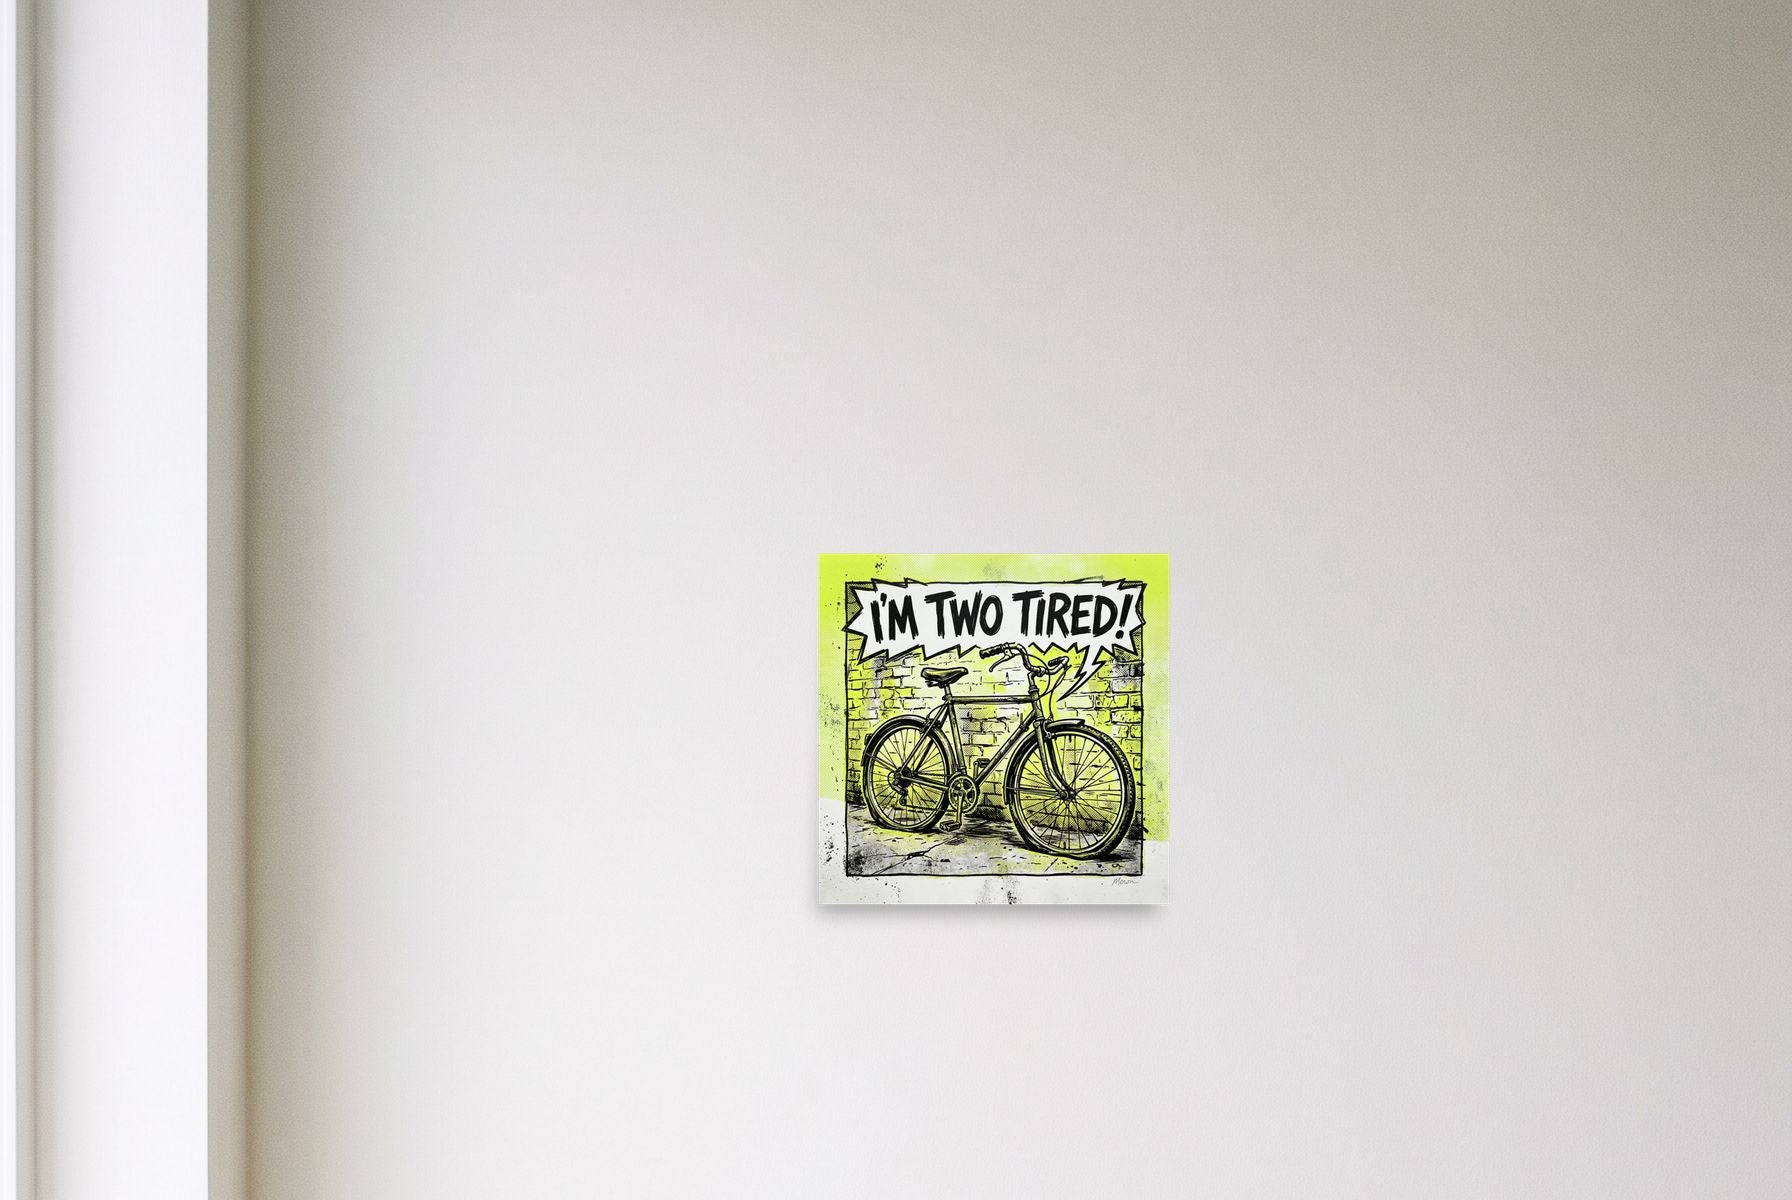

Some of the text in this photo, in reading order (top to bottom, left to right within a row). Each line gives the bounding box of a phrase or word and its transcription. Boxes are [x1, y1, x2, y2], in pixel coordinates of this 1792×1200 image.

[870, 590, 1134, 643] I'M TWO TIRED!
